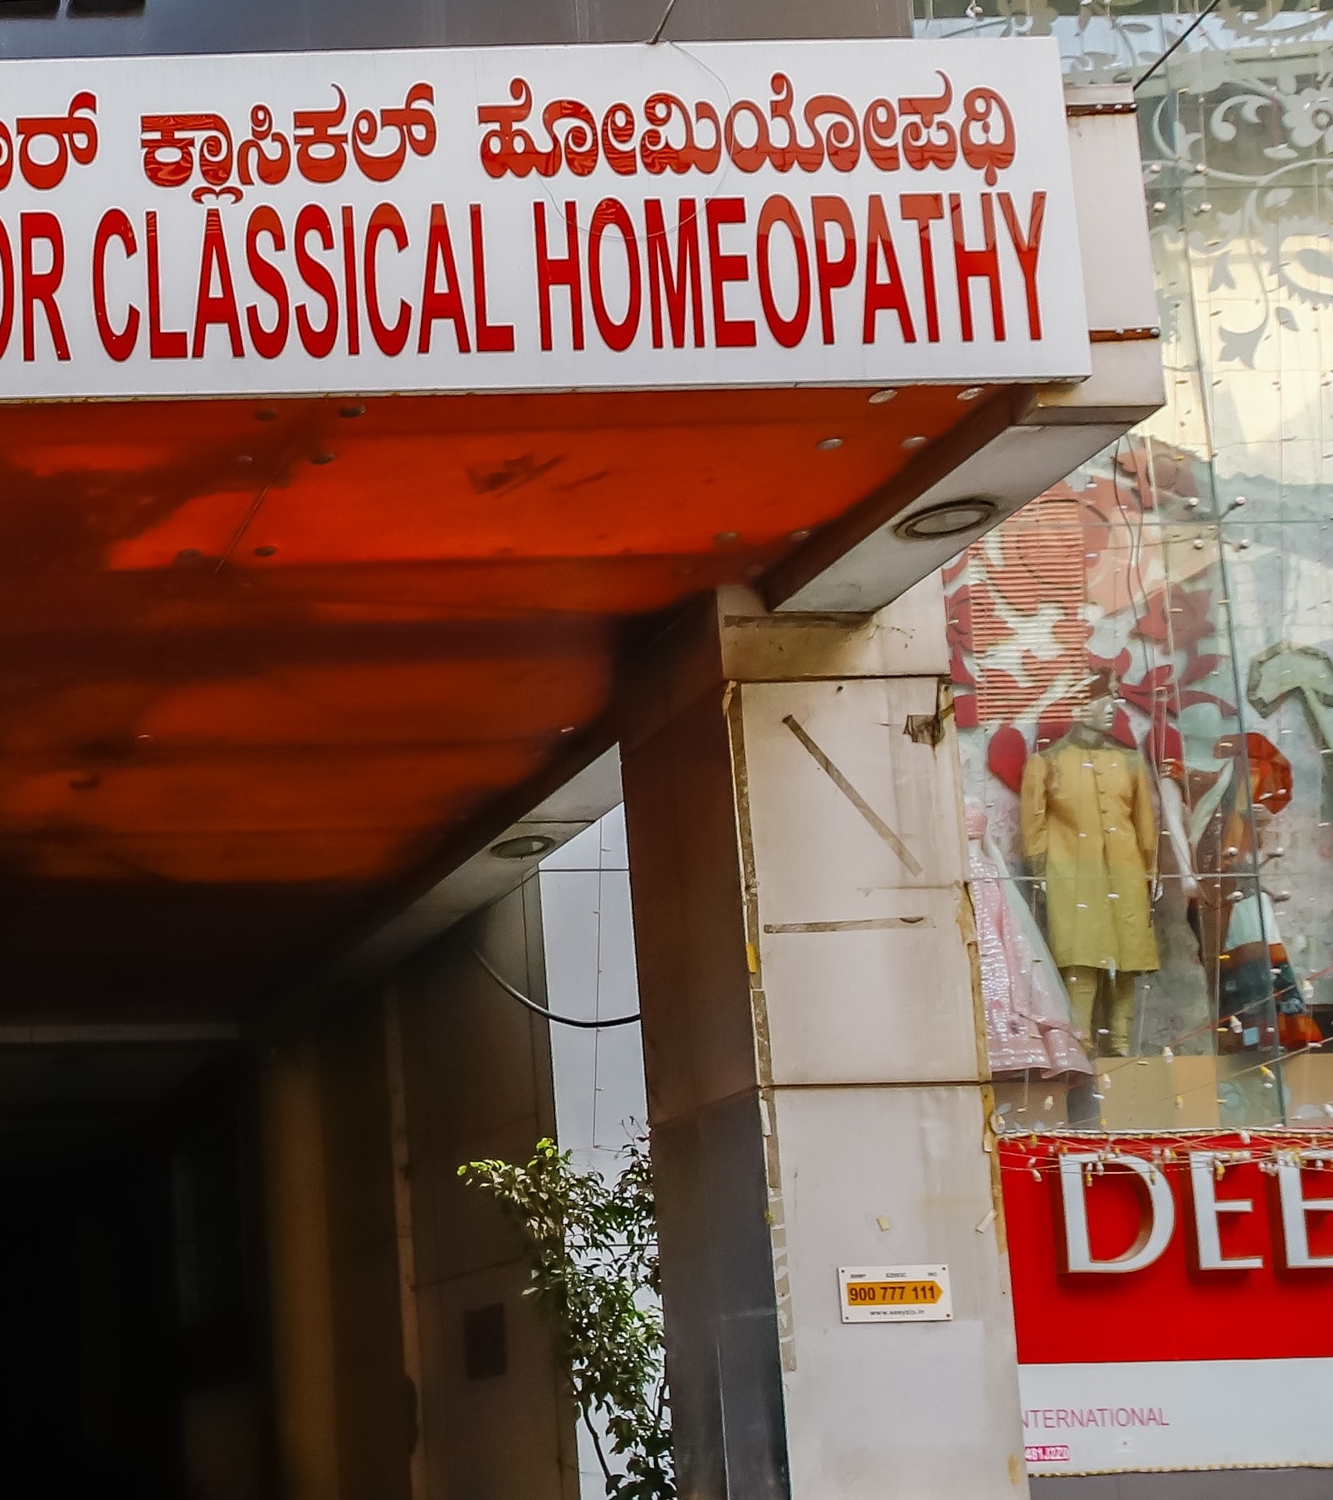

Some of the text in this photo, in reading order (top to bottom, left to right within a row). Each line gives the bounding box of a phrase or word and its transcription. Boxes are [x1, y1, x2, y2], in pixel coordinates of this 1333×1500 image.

[91, 203, 514, 364] CLASSICAL
[534, 191, 1047, 353] HOMEOPATHY
[849, 1285, 935, 1301] 900 777 111
